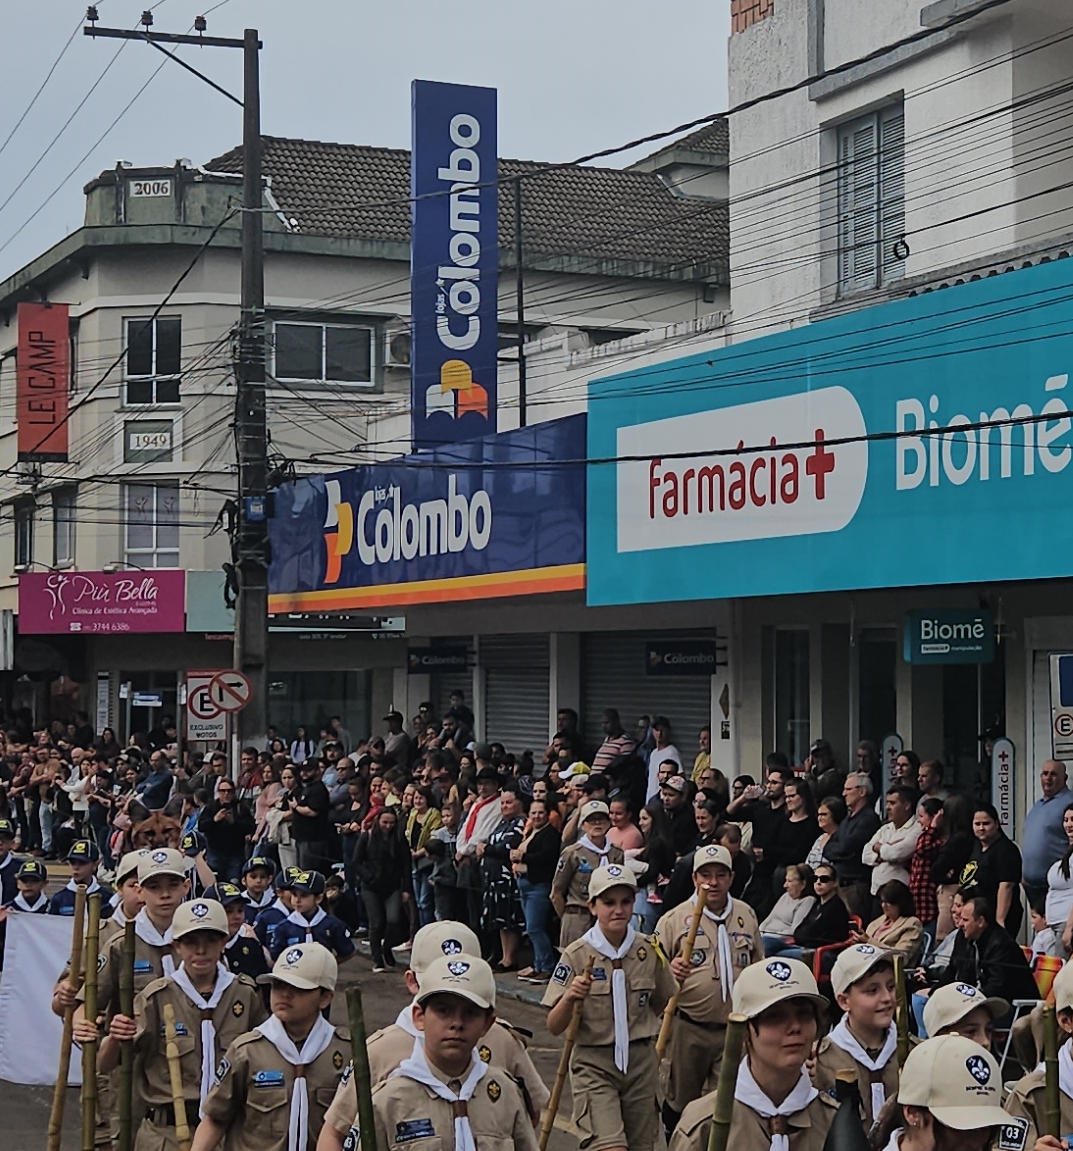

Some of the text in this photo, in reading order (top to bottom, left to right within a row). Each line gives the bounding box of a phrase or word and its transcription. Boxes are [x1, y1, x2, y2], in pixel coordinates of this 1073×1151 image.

[134, 181, 169, 196] 2006
[436, 113, 481, 351] Colombo
[134, 434, 167, 448] 1949
[357, 474, 492, 565] Colombo
[114, 578, 159, 602] Bella
[92, 622, 110, 632] 3744
[421, 655, 465, 665] Colombo
[664, 652, 714, 664] Colombo
[1060, 718, 1071, 732] E
[1006, 1126, 1019, 1139] 03
